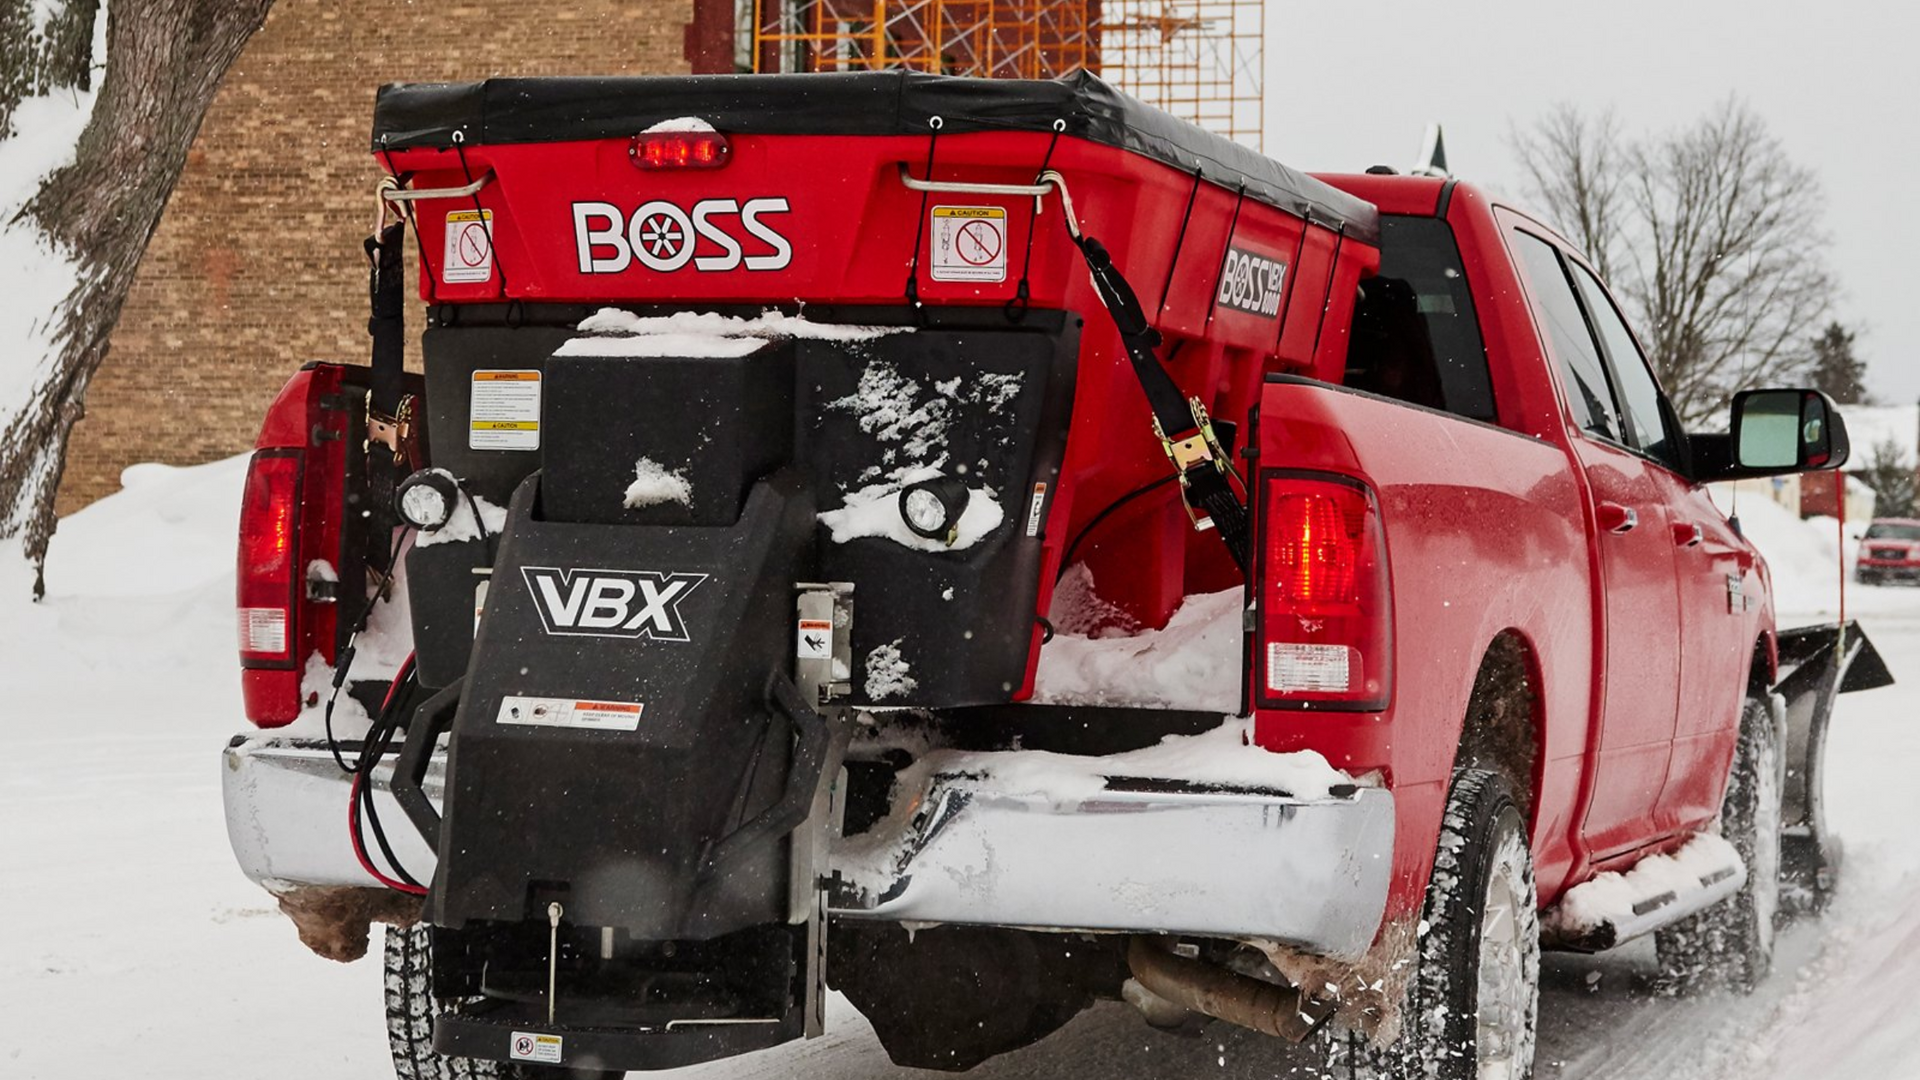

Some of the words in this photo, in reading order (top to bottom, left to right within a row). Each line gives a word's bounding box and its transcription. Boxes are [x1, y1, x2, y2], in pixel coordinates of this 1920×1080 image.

[571, 198, 792, 273] BOSS
[1219, 249, 1269, 312] BOSS
[536, 575, 688, 632] VBX
